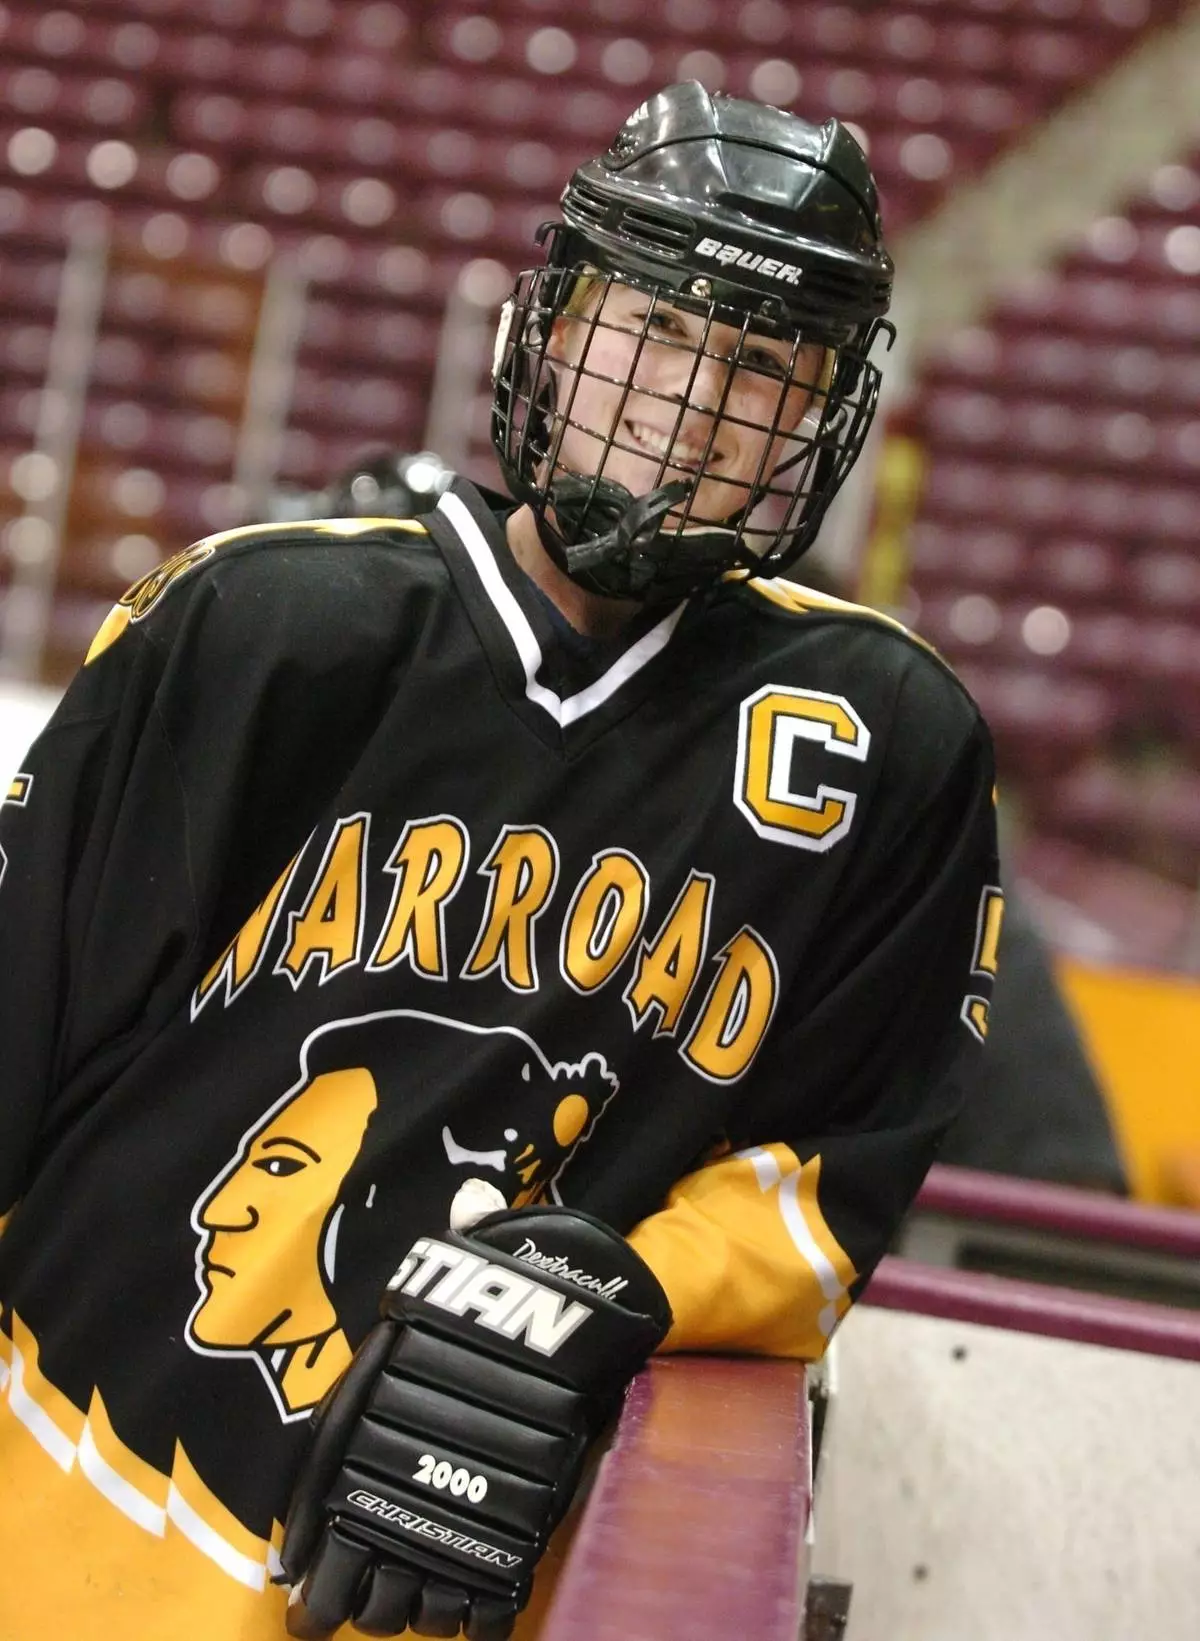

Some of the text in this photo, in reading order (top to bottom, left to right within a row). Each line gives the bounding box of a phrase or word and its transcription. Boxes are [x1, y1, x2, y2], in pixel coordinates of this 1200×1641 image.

[733, 683, 871, 852] C
[412, 1454, 488, 1504] 2000
[347, 1489, 523, 1569] CHRISTIAN
